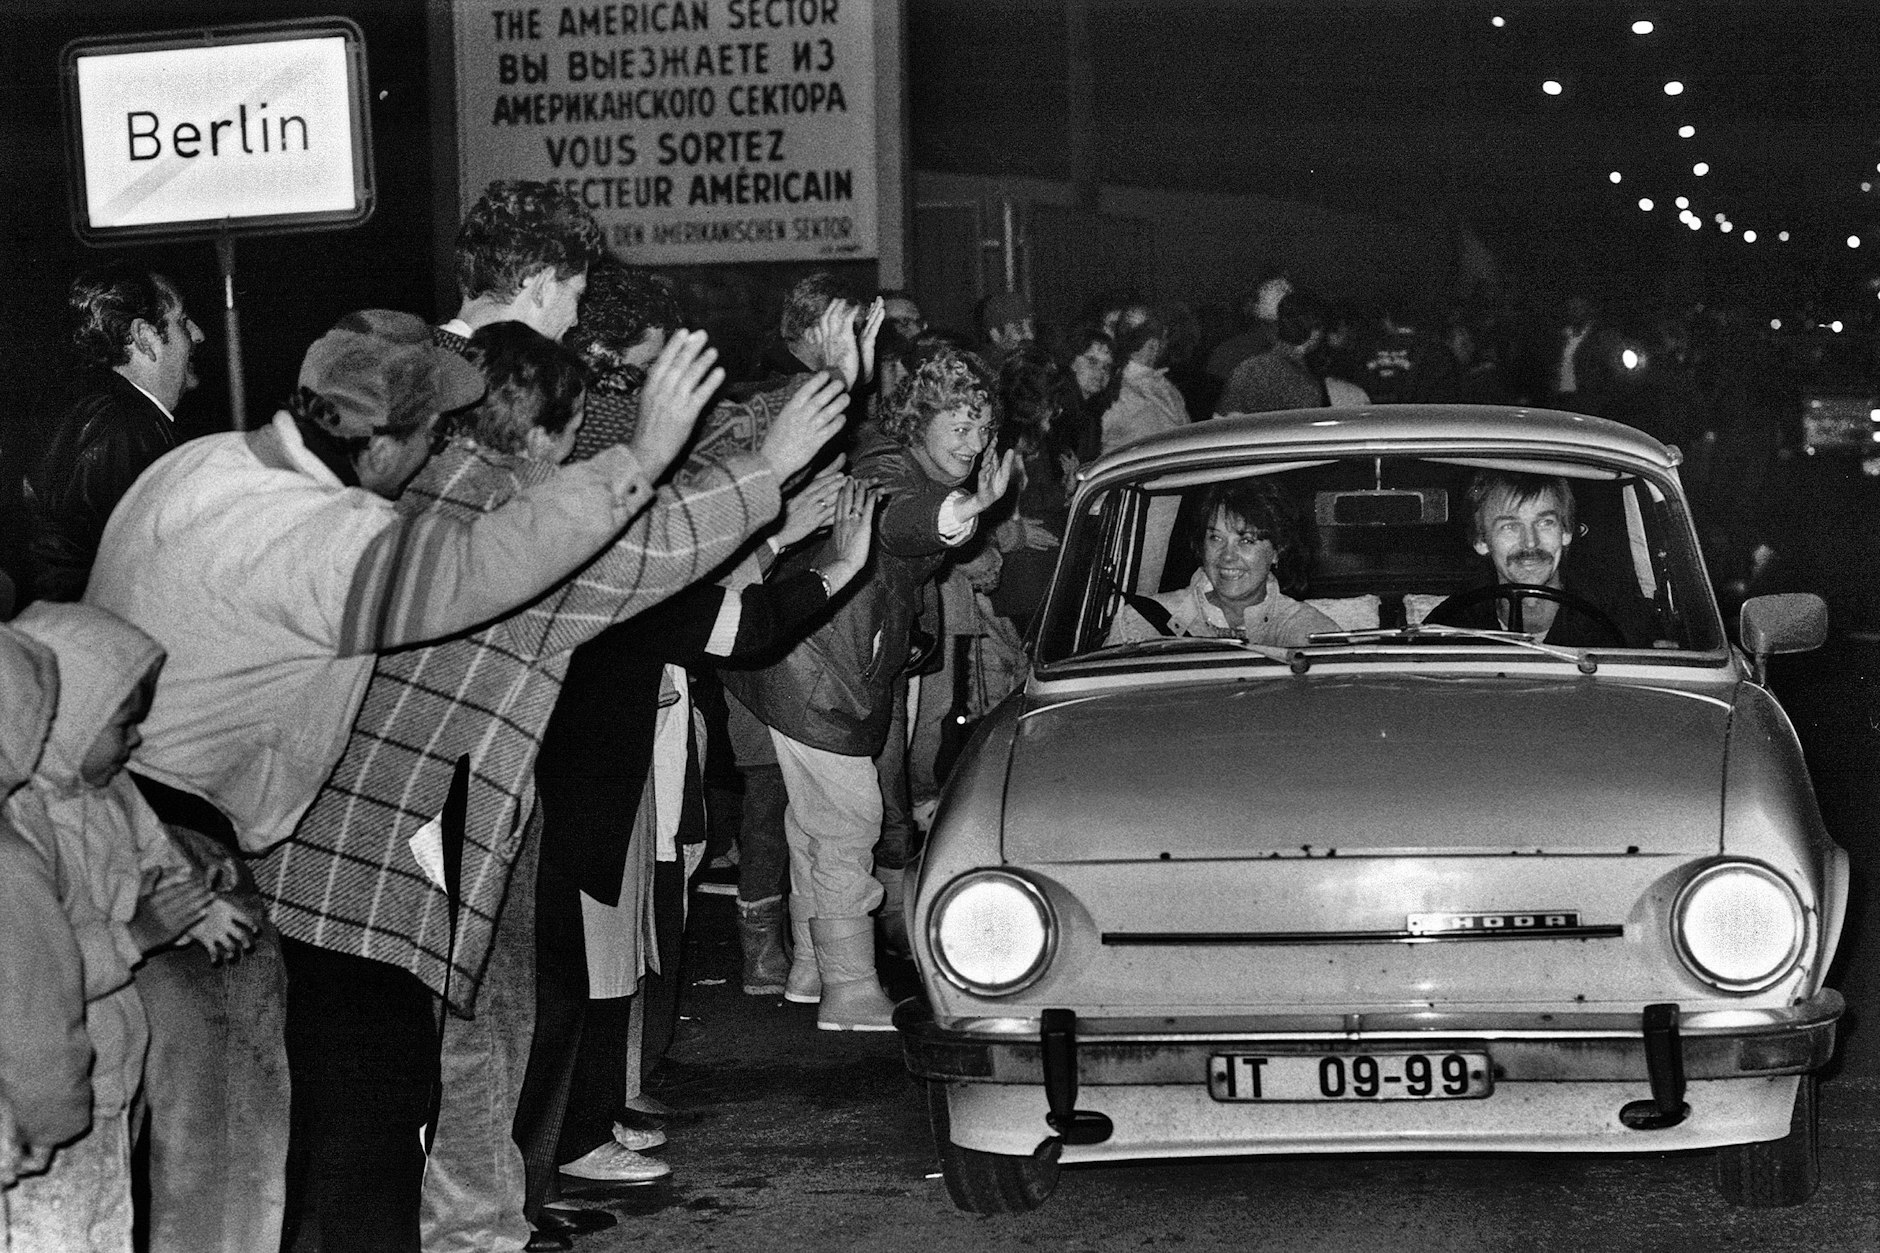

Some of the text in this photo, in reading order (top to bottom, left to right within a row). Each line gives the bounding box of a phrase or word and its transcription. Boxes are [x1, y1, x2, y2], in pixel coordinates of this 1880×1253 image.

[492, 0, 838, 41] THE AMERICAN SECTOR
[500, 38, 835, 85] ВЫ ВЫЕЗЖАЕТЕ ИЗ
[492, 81, 848, 126] АМЕРИКАНСКОГО СЕКТОРА
[127, 102, 309, 161] Berlin
[545, 129, 785, 168] VOUS SORTEZ
[689, 166, 853, 206] AMÉRICAIN
[1226, 1054, 1469, 1098] IT 09-99
